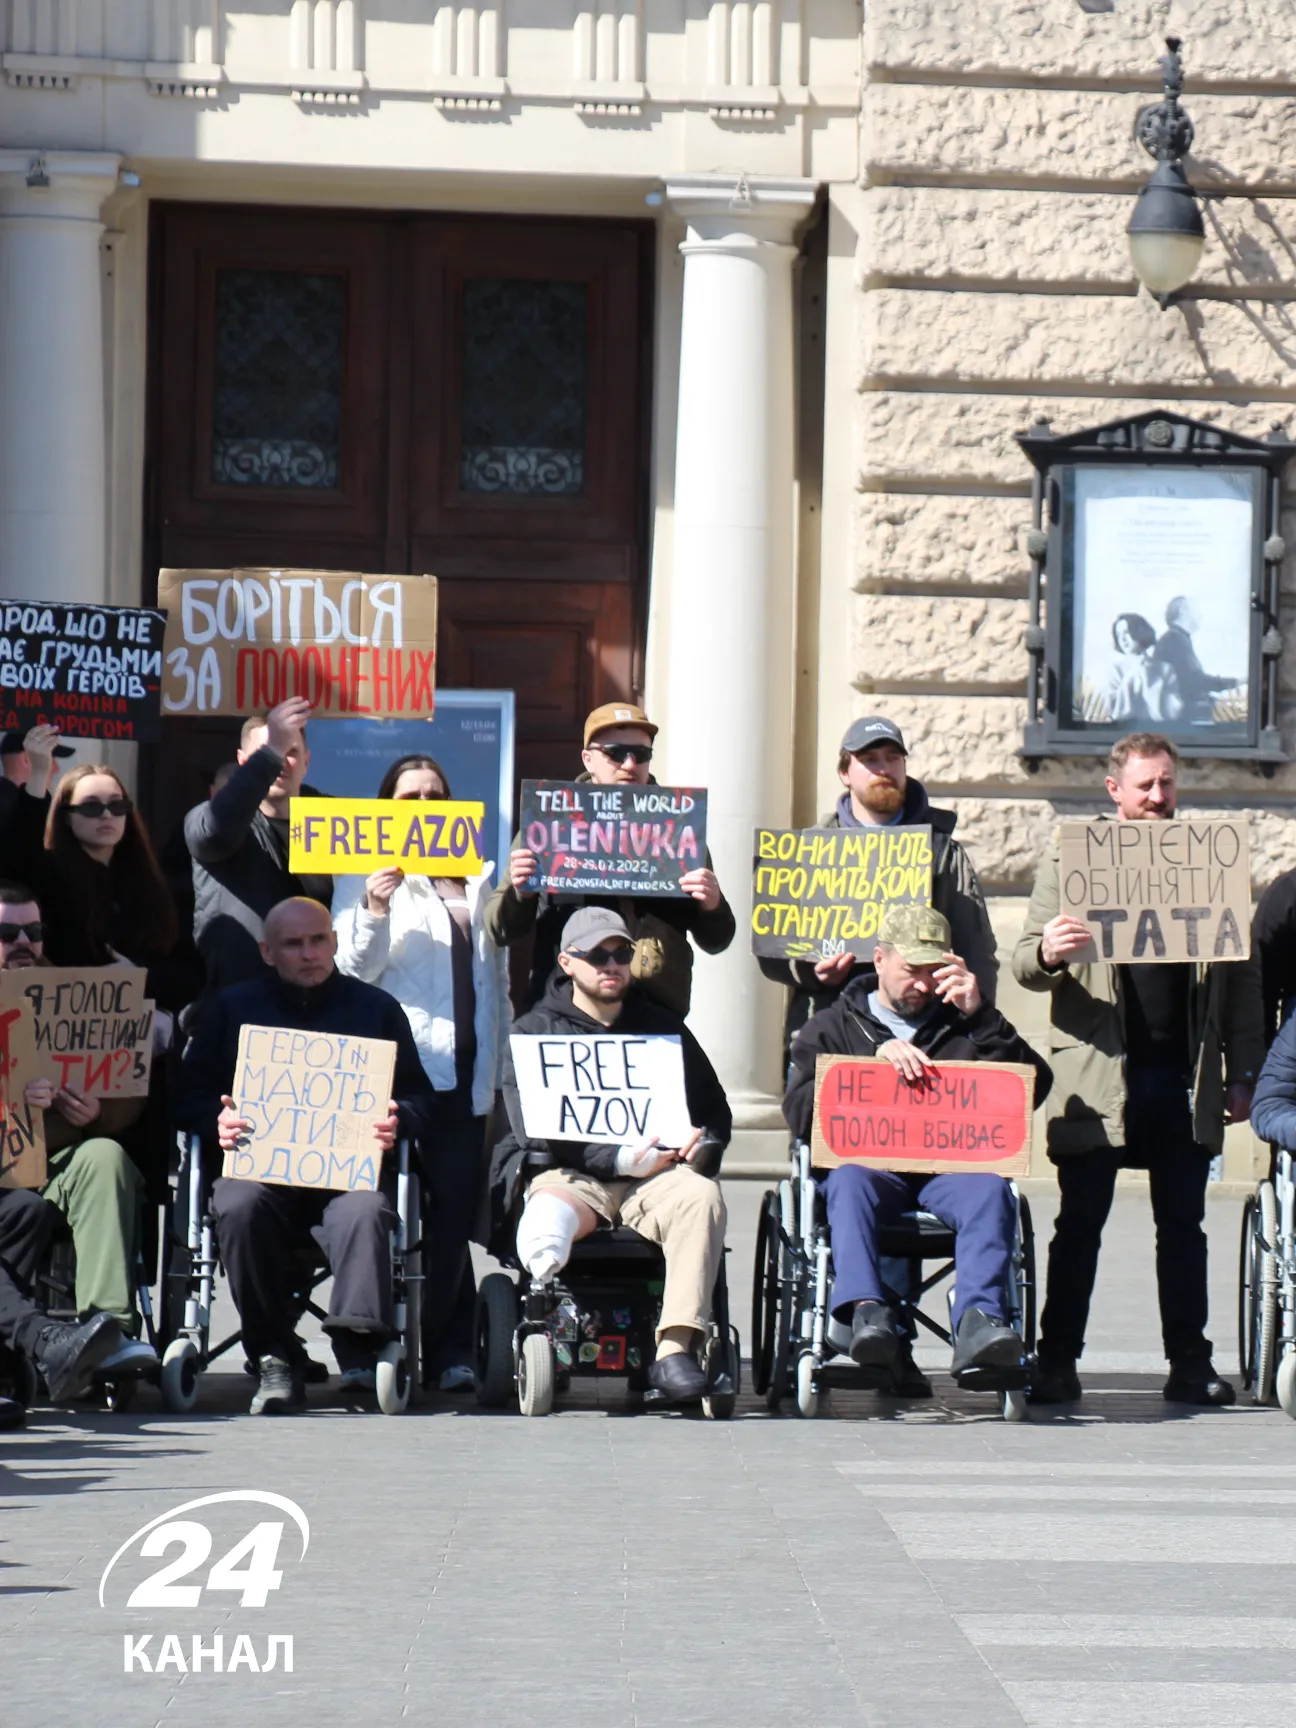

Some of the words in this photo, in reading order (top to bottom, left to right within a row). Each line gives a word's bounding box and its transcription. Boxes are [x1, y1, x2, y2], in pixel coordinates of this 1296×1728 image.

[181, 571, 403, 648] БОРІТЬСЯ
[117, 616, 152, 644] НЕ
[0, 662, 56, 690] ВОЇХ
[39, 640, 161, 677] ГРУДЬМИ
[163, 646, 221, 711] ЗА
[535, 790, 584, 812] TELL
[589, 791, 624, 812] THE
[633, 793, 695, 814] WORLD
[596, 812, 624, 820] ABOUT
[290, 815, 395, 855] #FREE
[401, 814, 485, 860] AZOV
[758, 831, 837, 866] ВОНИ
[839, 831, 934, 867] МРІЮТЬ
[1086, 824, 1240, 868] МРІЄМО
[756, 867, 808, 899] ПРО
[807, 867, 871, 900] МИТЬ
[870, 866, 932, 900] КОЛИ
[1065, 866, 1225, 906] ОБІЙНЯТИ
[752, 903, 859, 939] СТАНУТЬ
[1087, 907, 1244, 959] ТАТА
[51, 1049, 131, 1093] ТИ?
[538, 1040, 650, 1091] FREE
[240, 1062, 376, 1113] МАЮТЬ
[838, 1070, 875, 1103] НЕ
[894, 1076, 978, 1110] МОВЧИ
[239, 1101, 337, 1148] БУТИ
[559, 1094, 652, 1137] AZOV
[830, 1115, 906, 1148] ПОЛОН
[924, 1119, 1006, 1150] ВБИВАЄ
